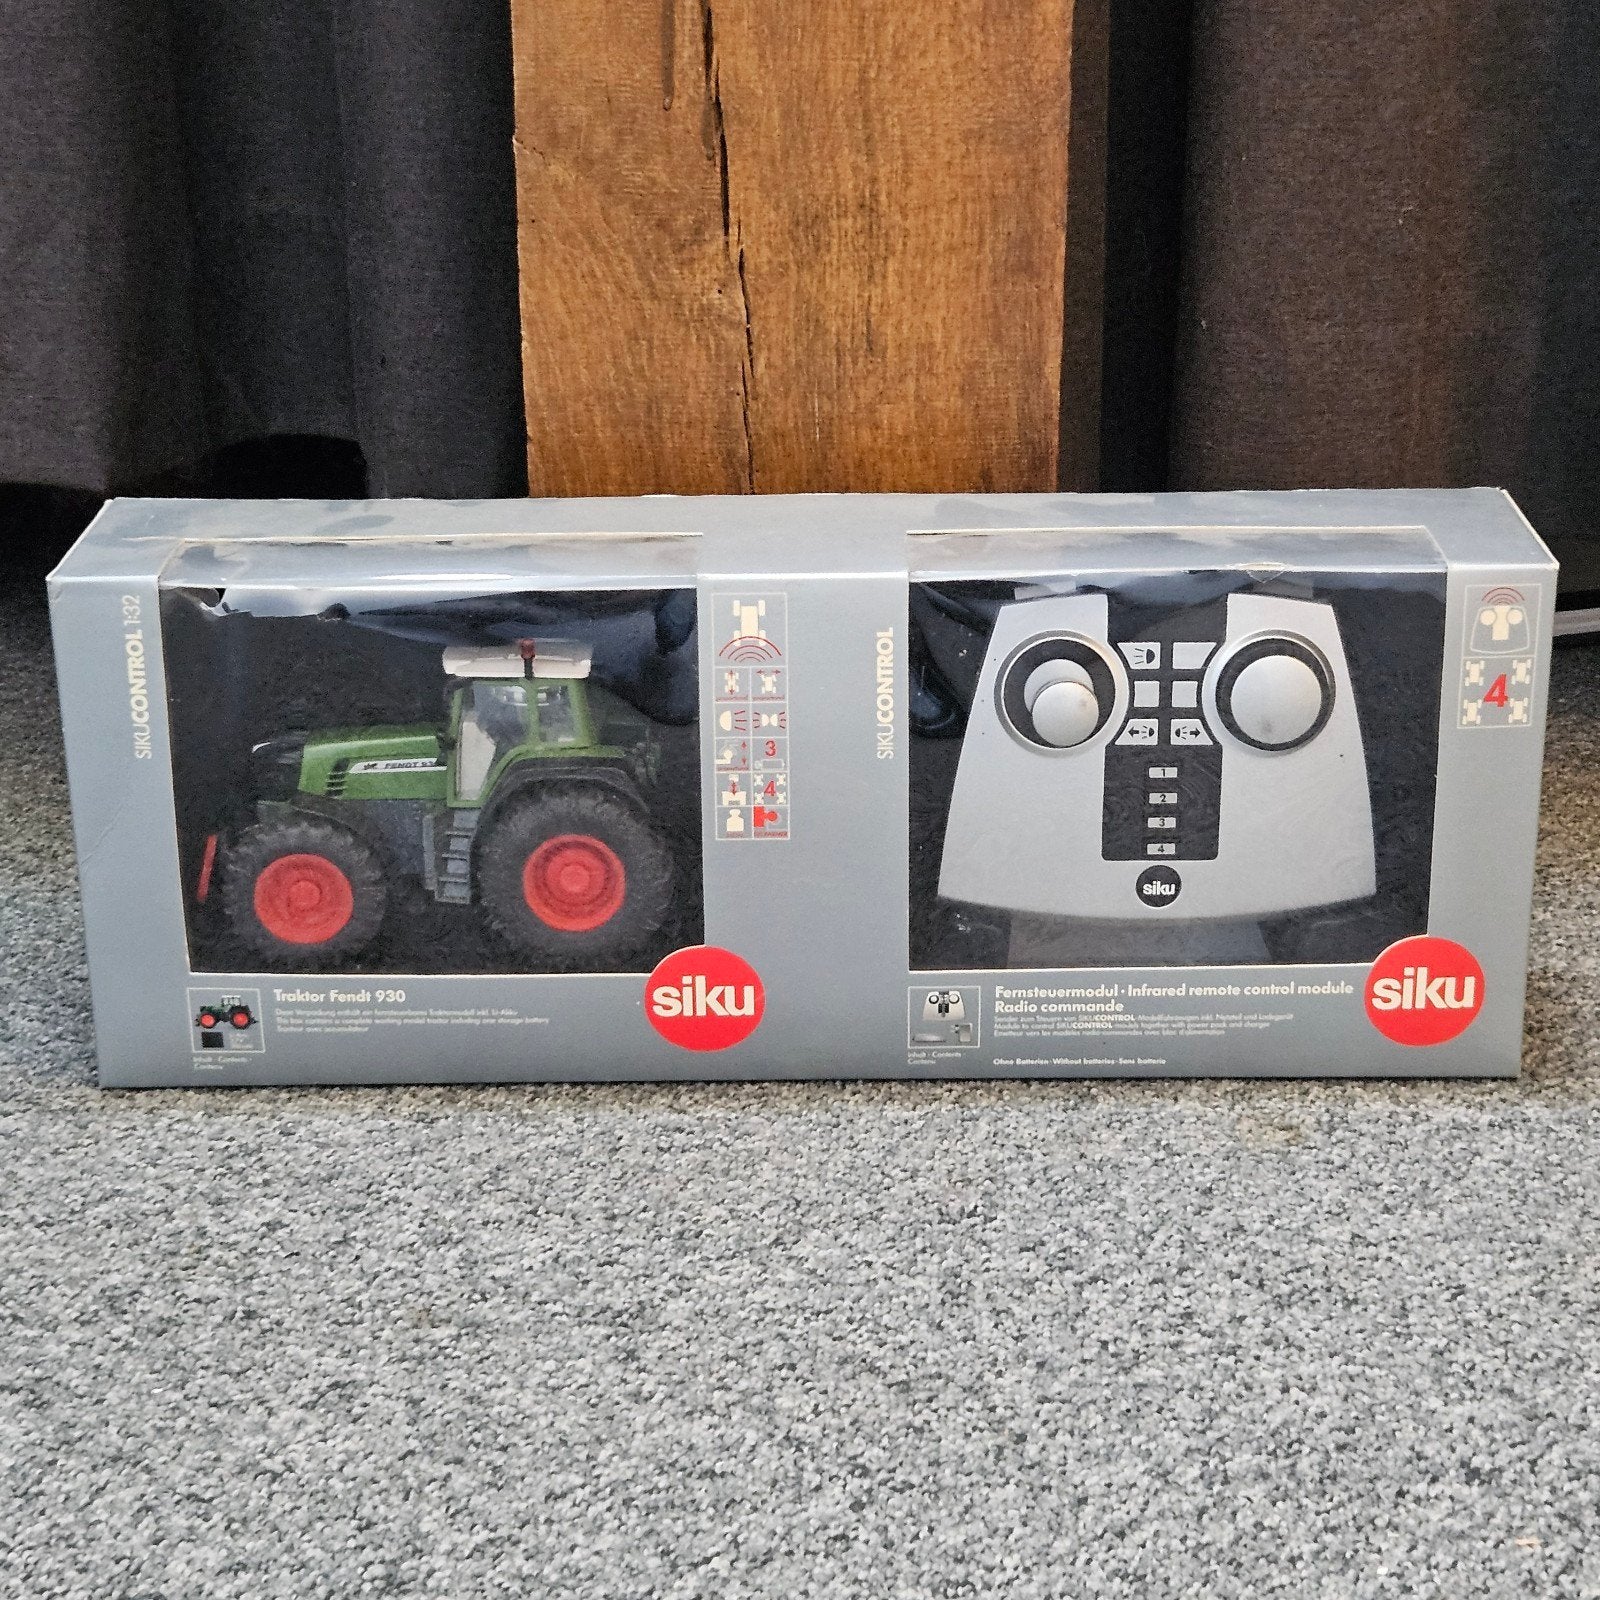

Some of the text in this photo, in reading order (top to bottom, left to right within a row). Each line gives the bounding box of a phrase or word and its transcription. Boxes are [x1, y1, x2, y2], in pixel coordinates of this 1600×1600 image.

[122, 595, 152, 759] SIKUCONTROL 1:32
[876, 627, 894, 760] SIKUCONTROL
[1483, 673, 1509, 708] 4
[765, 740, 776, 757] 3
[763, 780, 776, 797] 4
[1159, 793, 1167, 803] 2
[1158, 818, 1165, 827] 3
[1157, 845, 1165, 853] 4
[1142, 880, 1176, 896] siku
[273, 988, 406, 1003] Traktor Fendt 930
[652, 975, 755, 1017] siku
[995, 981, 1354, 998] Fernsteuermodul Infrared remote control module
[1371, 966, 1476, 1012] siku
[995, 999, 1125, 1013] Radio commande
